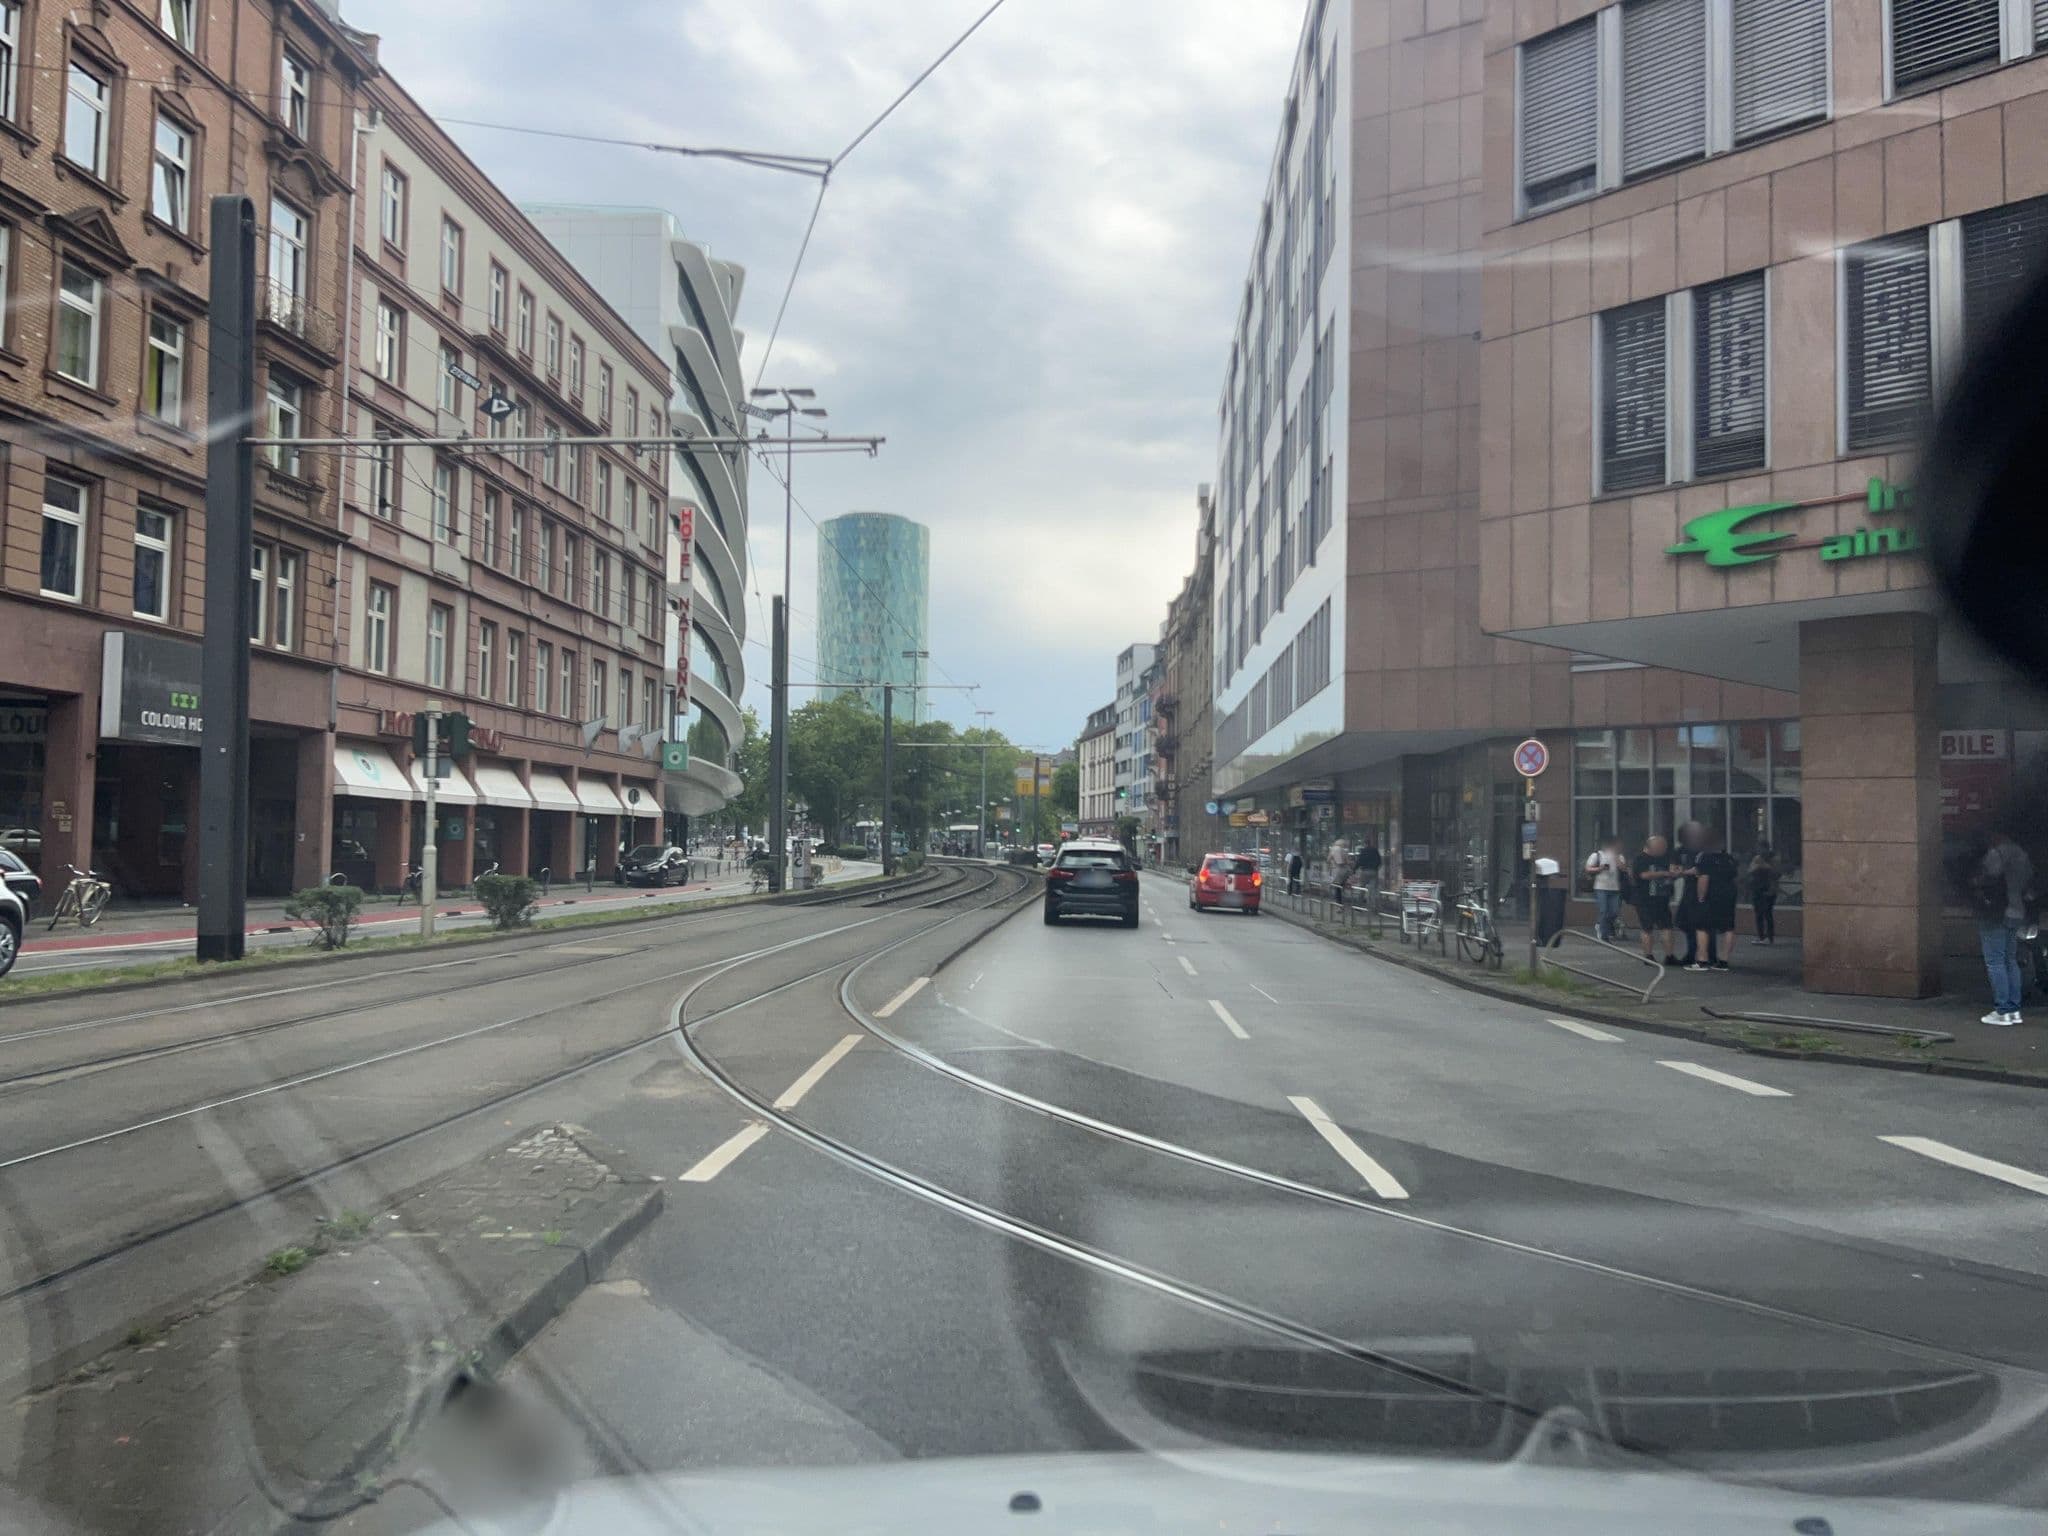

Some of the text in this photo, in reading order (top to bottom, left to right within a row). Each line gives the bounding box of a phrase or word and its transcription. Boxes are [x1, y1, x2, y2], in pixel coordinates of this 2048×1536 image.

[677, 508, 692, 715] HOTEL NATIONAL
[141, 711, 186, 730] COLOUR
[1940, 735, 1995, 756] BILE
